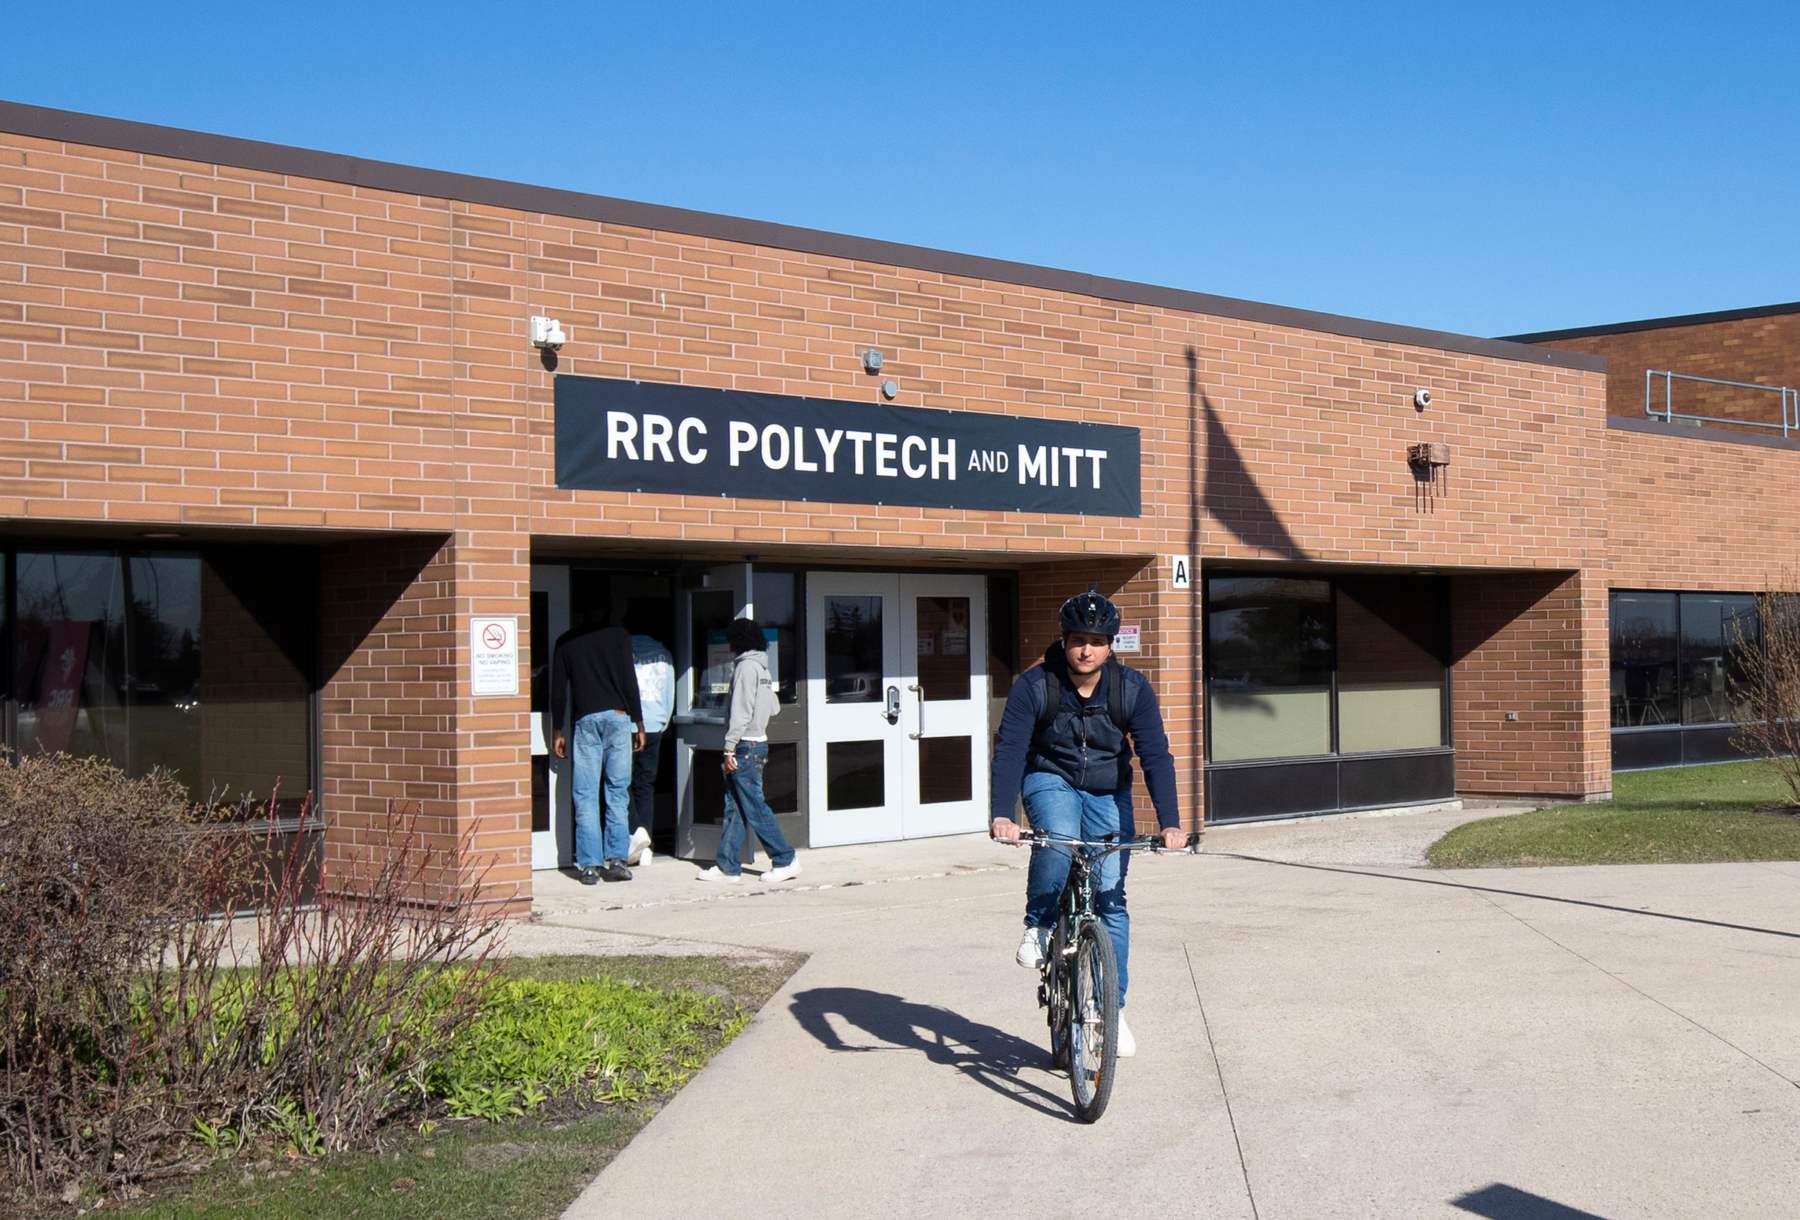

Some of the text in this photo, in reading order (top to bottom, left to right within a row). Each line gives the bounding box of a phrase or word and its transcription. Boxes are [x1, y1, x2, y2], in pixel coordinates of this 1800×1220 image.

[606, 411, 1108, 489] RRC POLYTECH AND MITT
[1175, 560, 1187, 583] A
